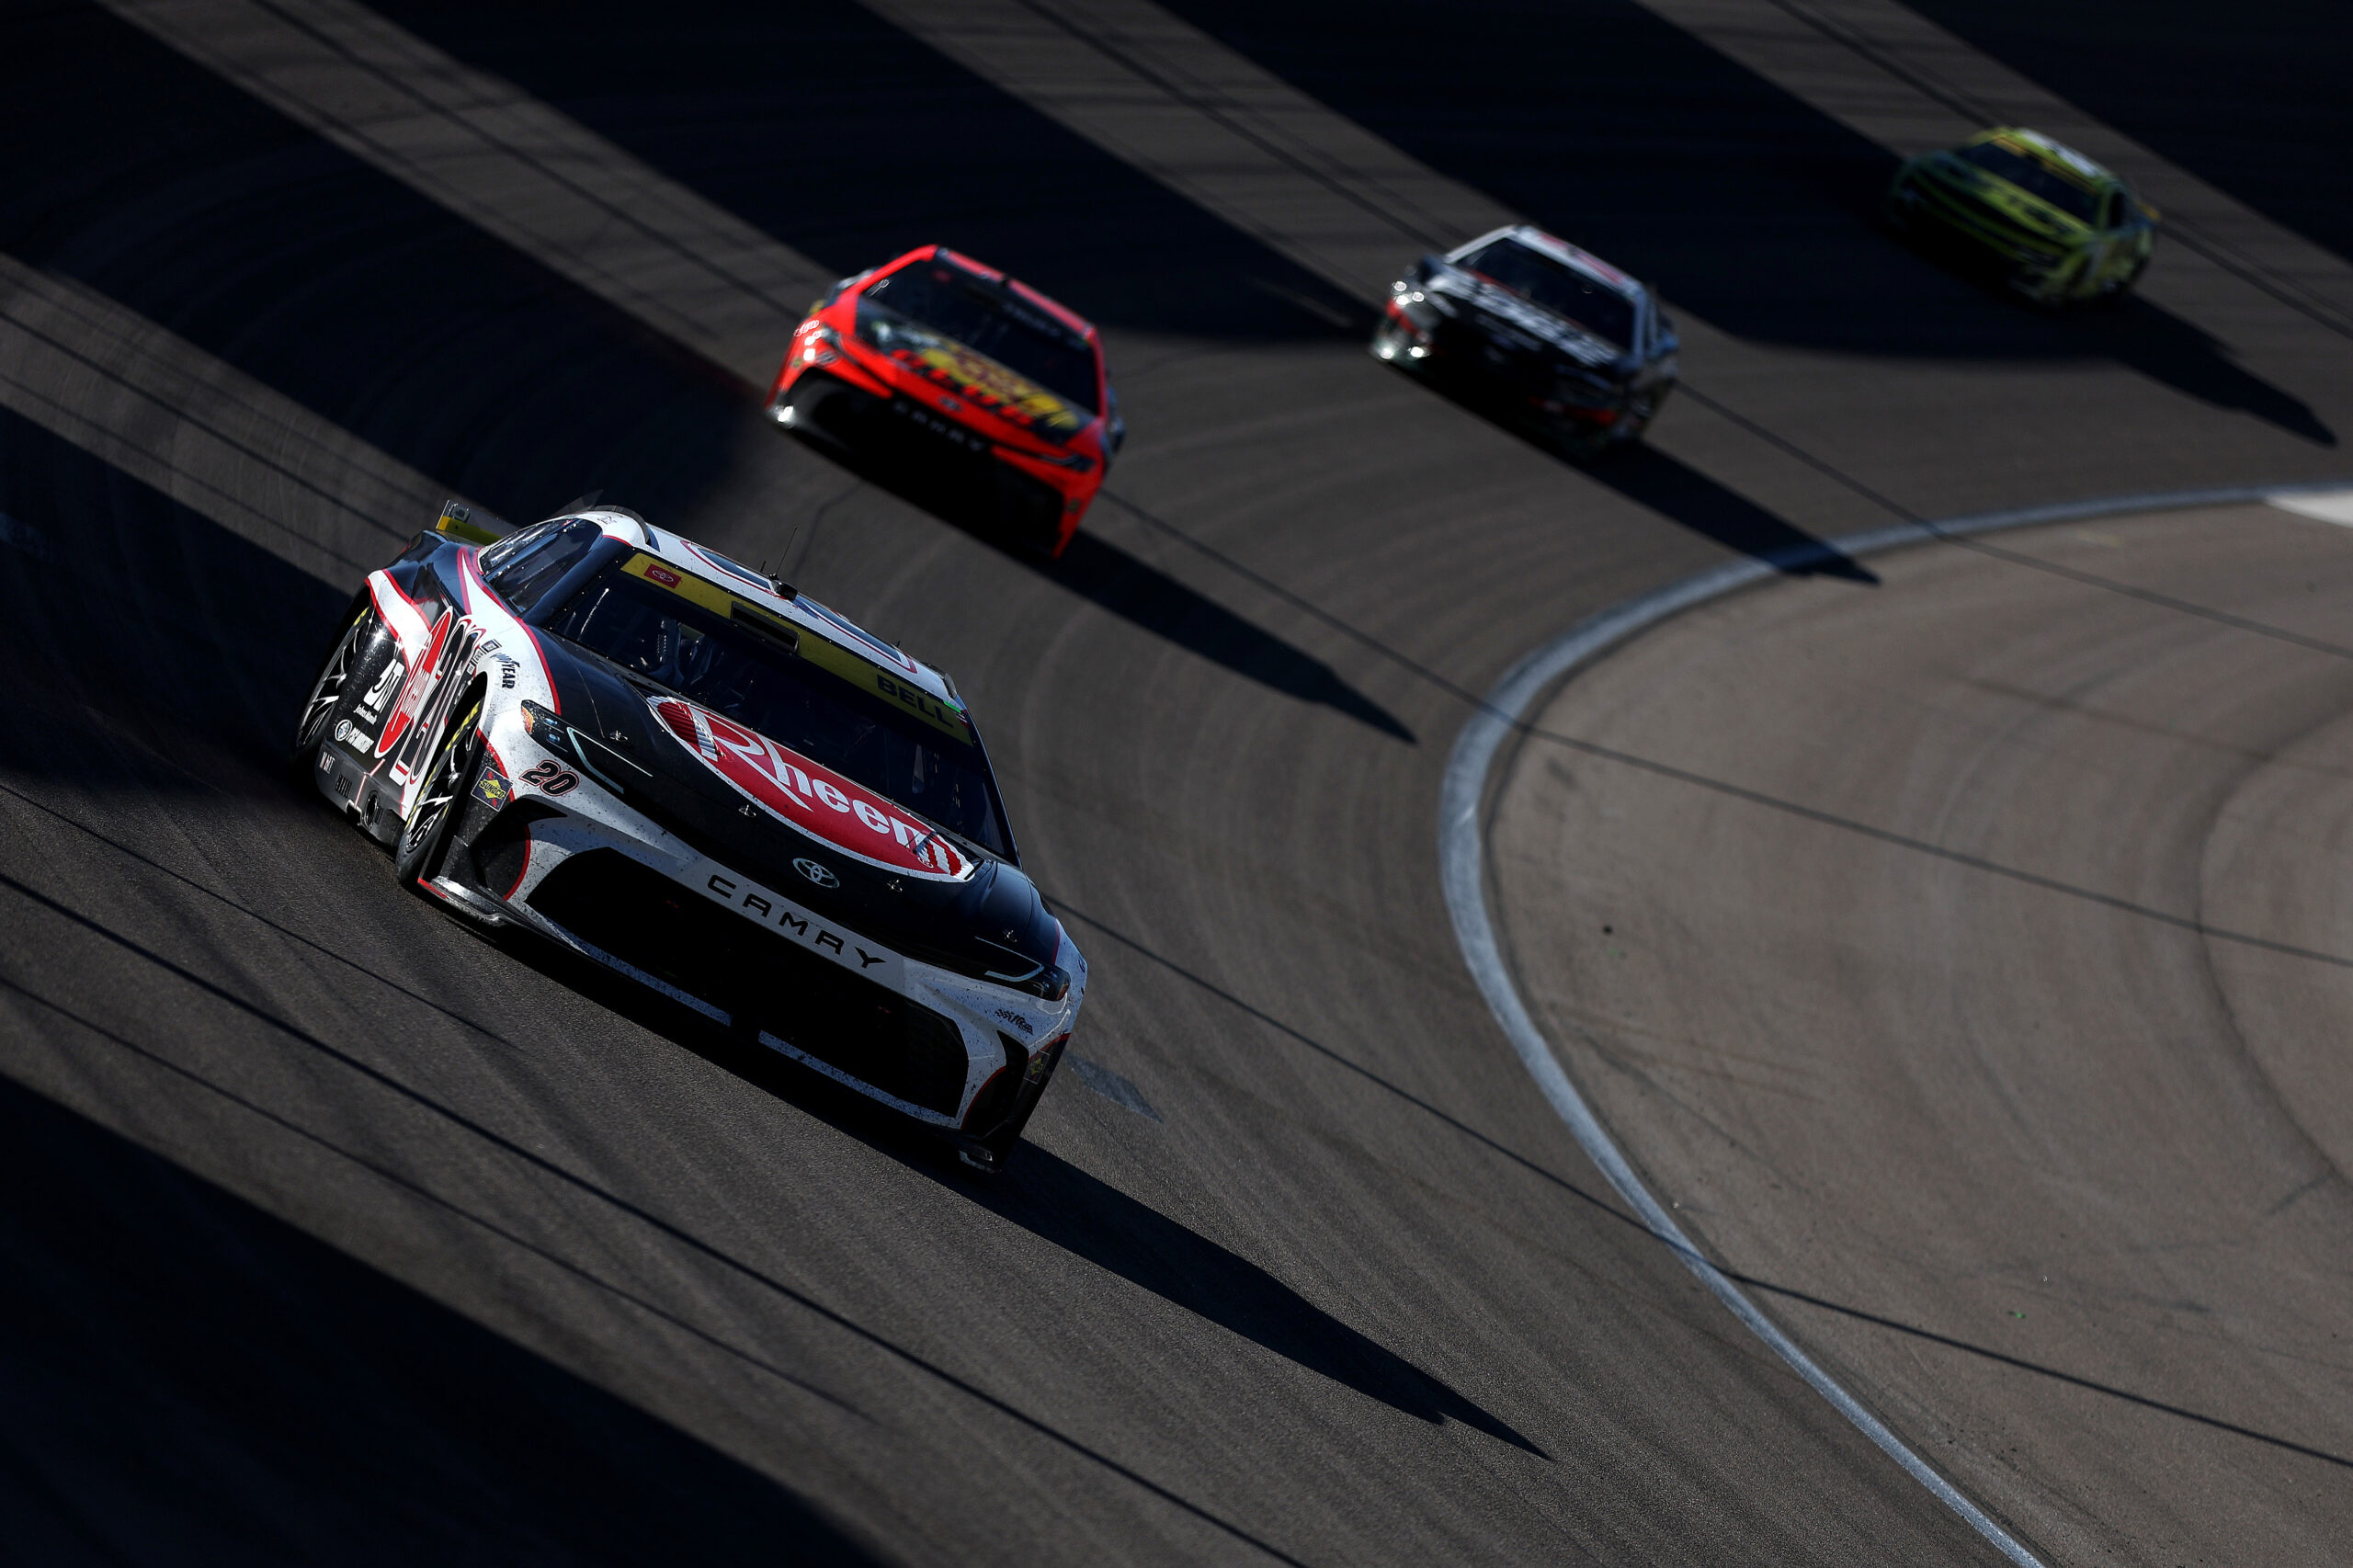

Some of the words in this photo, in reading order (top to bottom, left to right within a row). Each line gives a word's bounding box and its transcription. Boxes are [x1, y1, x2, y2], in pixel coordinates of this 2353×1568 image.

[877, 674, 954, 729] BELL
[478, 781, 506, 801] SUNOCO
[518, 759, 580, 797] 20
[688, 706, 952, 873] Rheem
[707, 874, 887, 969] CAMRY
